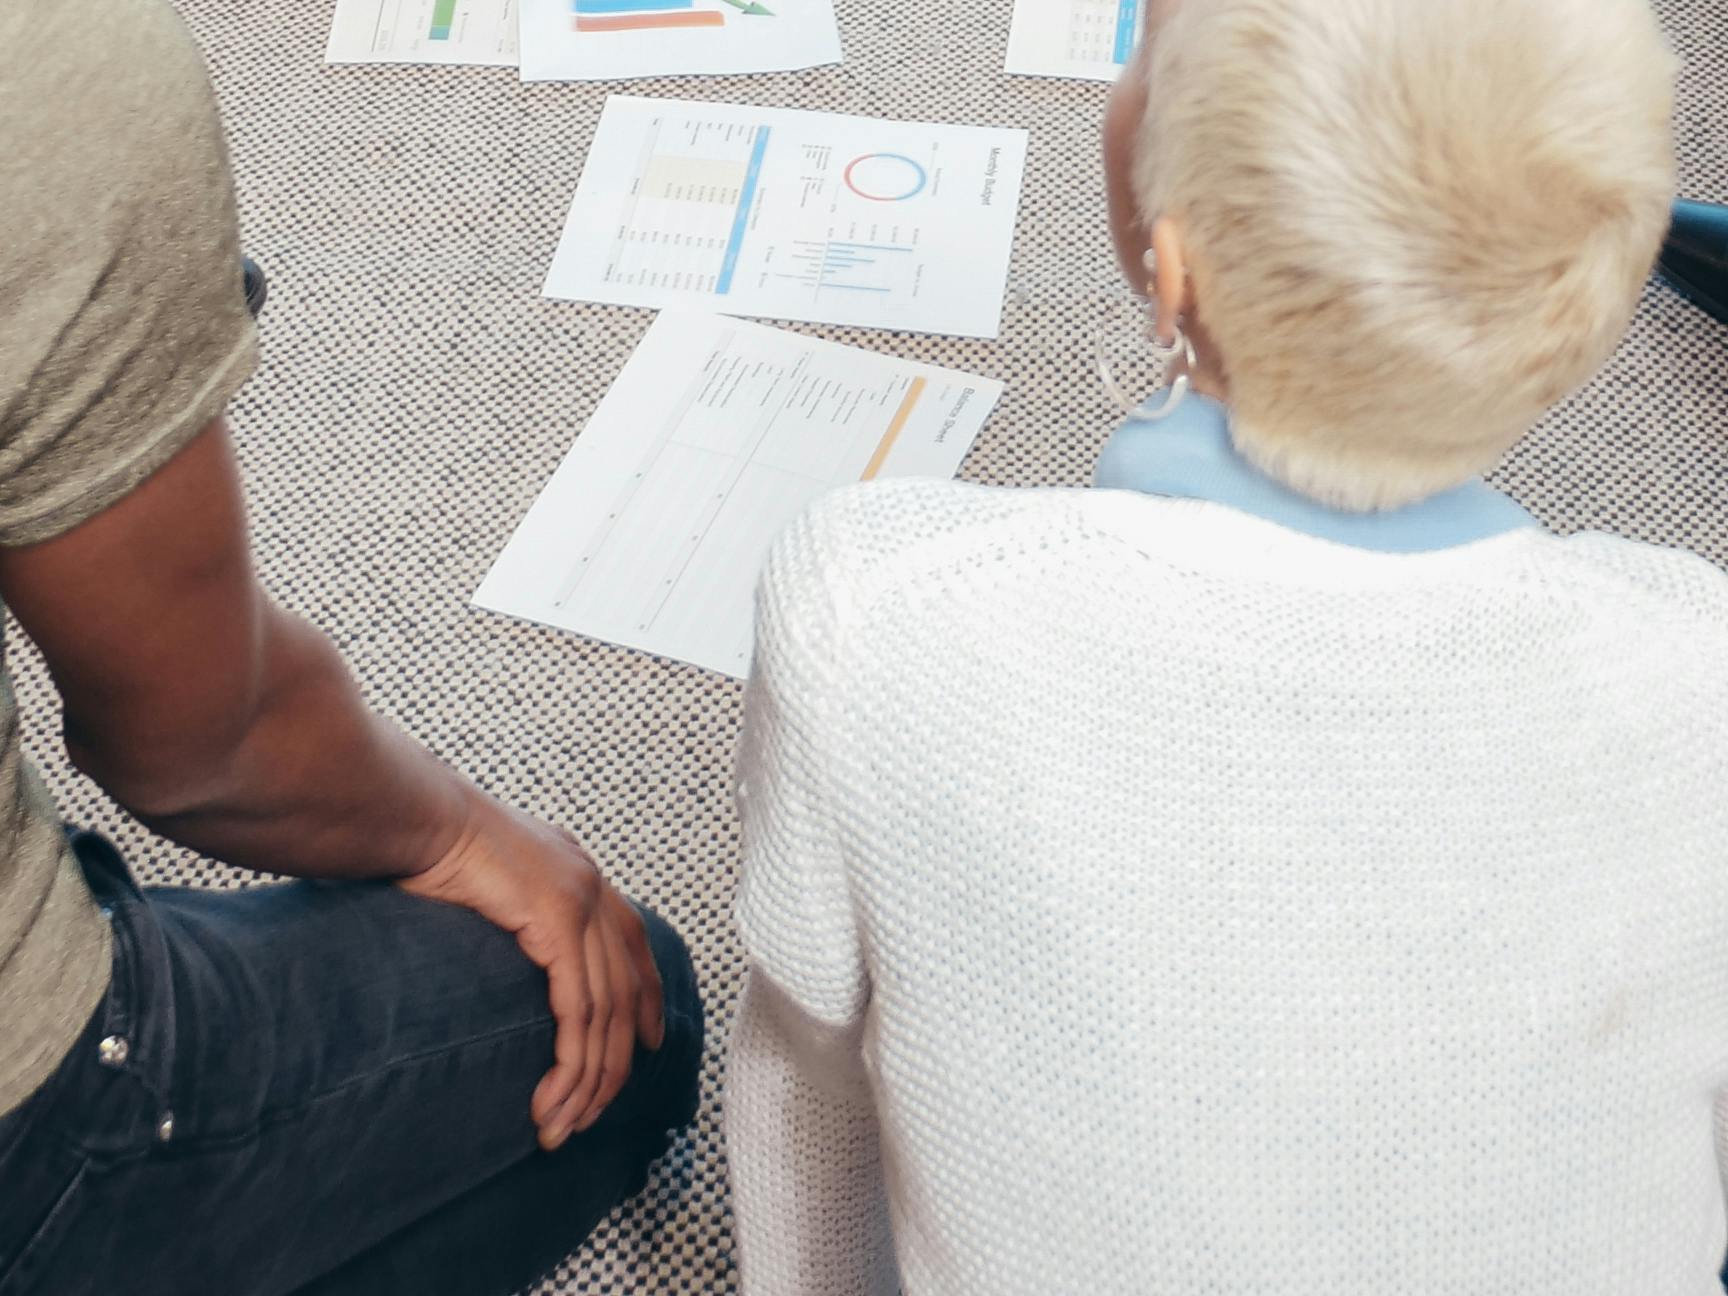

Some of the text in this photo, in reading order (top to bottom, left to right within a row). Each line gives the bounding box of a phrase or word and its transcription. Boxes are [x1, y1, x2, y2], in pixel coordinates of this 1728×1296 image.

[980, 146, 1001, 206] Monthly Budget
[948, 387, 975, 418] Balance
[934, 418, 955, 442] Sheet
